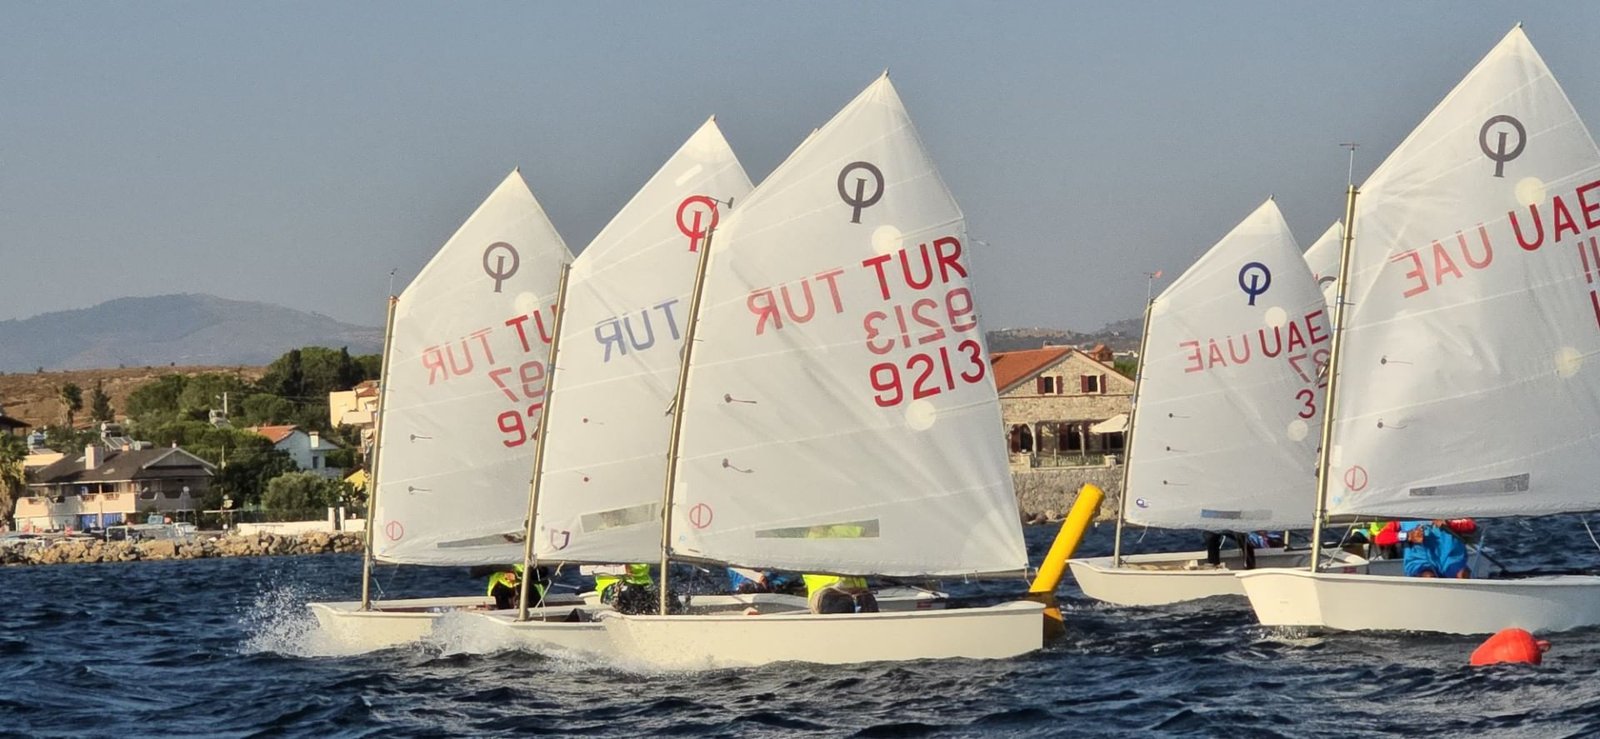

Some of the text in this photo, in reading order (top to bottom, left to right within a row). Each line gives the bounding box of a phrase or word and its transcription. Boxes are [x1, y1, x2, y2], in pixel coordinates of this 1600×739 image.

[1508, 179, 1600, 251] UAE
[862, 236, 968, 301] TUR
[1258, 309, 1329, 358] UAE
[869, 339, 986, 407] 9213
